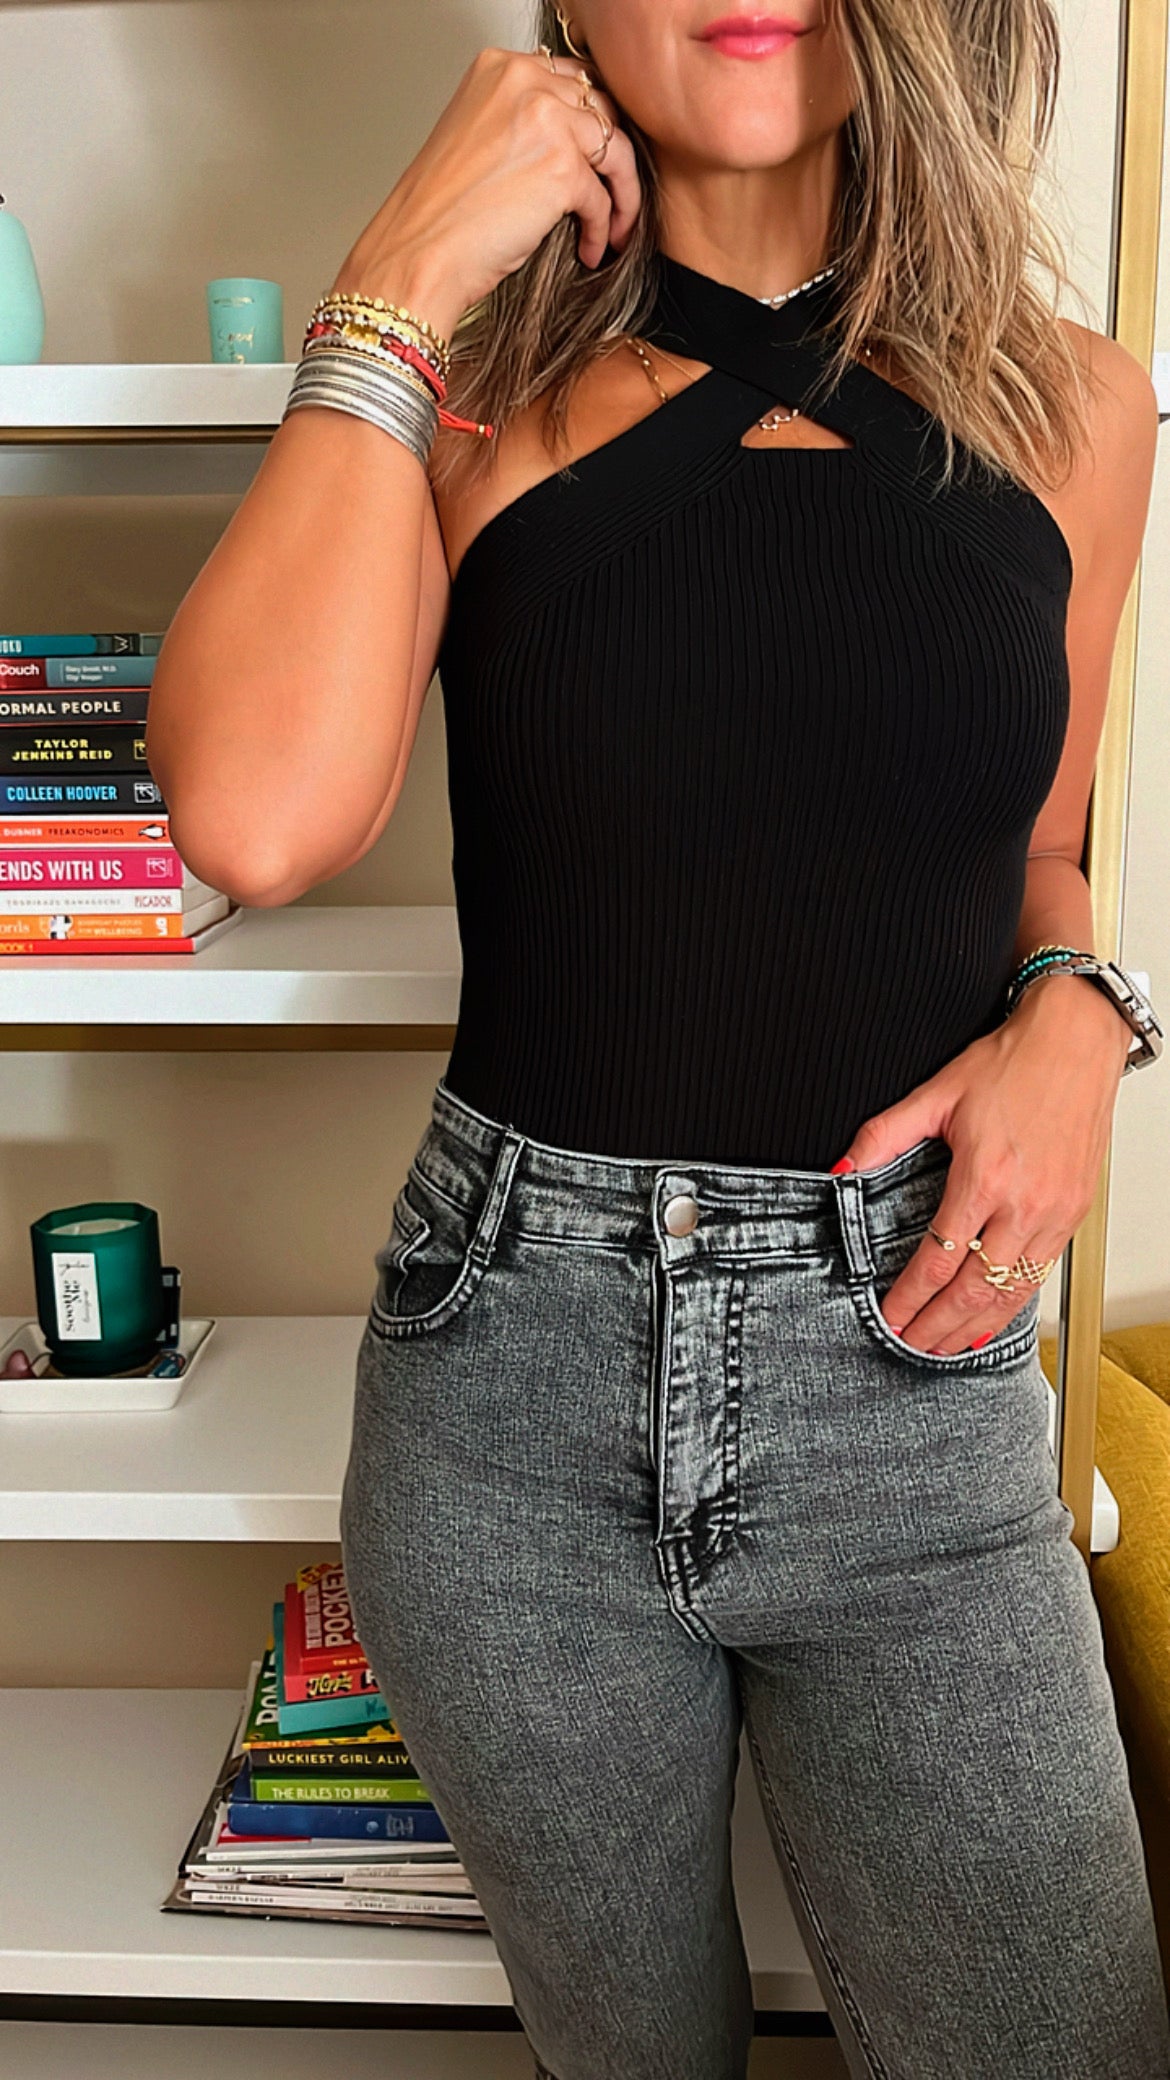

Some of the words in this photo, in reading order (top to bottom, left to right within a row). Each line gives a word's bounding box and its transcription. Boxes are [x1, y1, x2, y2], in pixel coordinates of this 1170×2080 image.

[0, 663, 40, 676] Couch
[61, 701, 121, 713] PEOPLE
[34, 739, 89, 749] TAYLOR
[12, 751, 74, 761] JENKINS
[79, 750, 113, 760] REID
[7, 786, 62, 801] COLLEEN
[66, 786, 118, 801] HOOVER
[4, 827, 43, 837] DUBNER
[48, 826, 124, 836] FREAKONOMICS
[0, 860, 44, 882] ENDS
[48, 860, 93, 881] WITH
[100, 860, 123, 881] US
[134, 895, 173, 908] PICADOR
[268, 1753, 334, 1764] LUCKIEST
[339, 1753, 372, 1764] GIRL
[272, 1787, 294, 1799] THE
[296, 1787, 332, 1800] RULES
[335, 1787, 351, 1800] TO
[354, 1787, 390, 1800] BREAK
